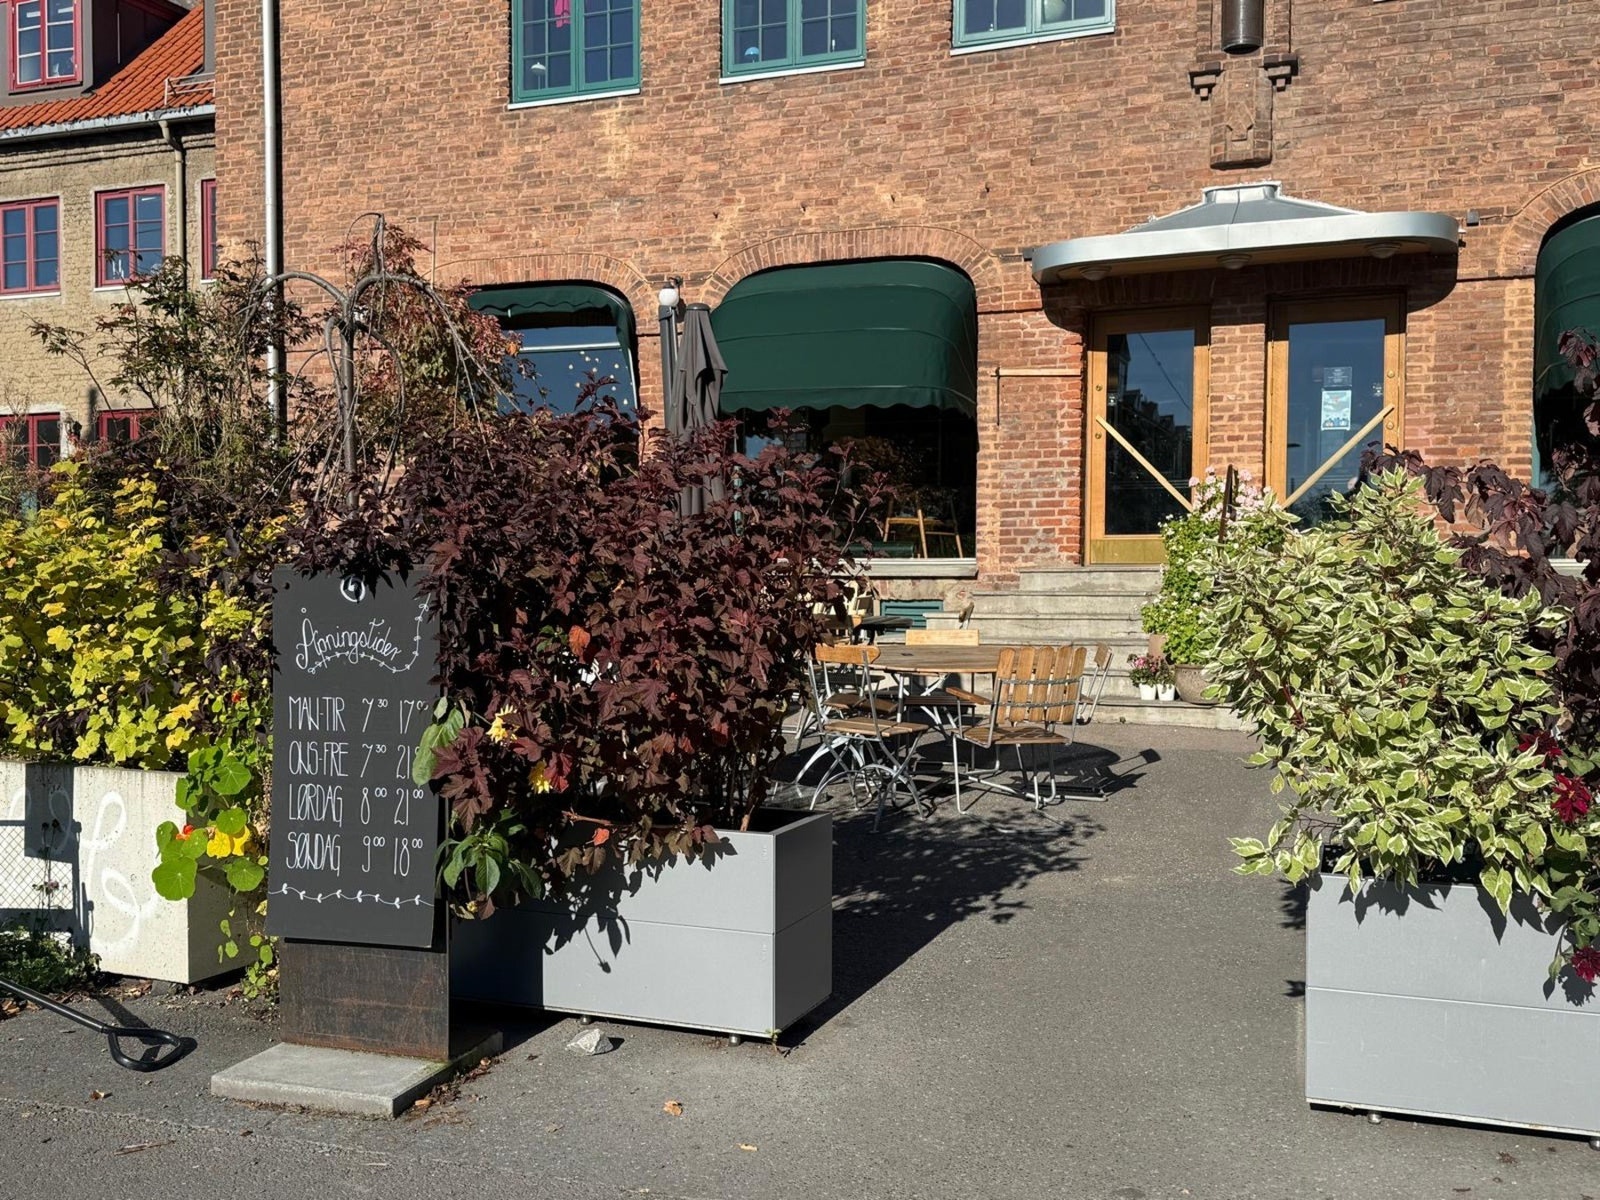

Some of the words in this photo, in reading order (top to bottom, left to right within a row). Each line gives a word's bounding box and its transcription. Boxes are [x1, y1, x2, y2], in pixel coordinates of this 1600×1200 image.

[295, 607, 402, 670] Åpningstider
[288, 696, 346, 732] MAN-TIR
[288, 740, 349, 777] ONS-FRE
[288, 783, 343, 828] LØRDAG
[285, 831, 341, 877] SØNDAG
